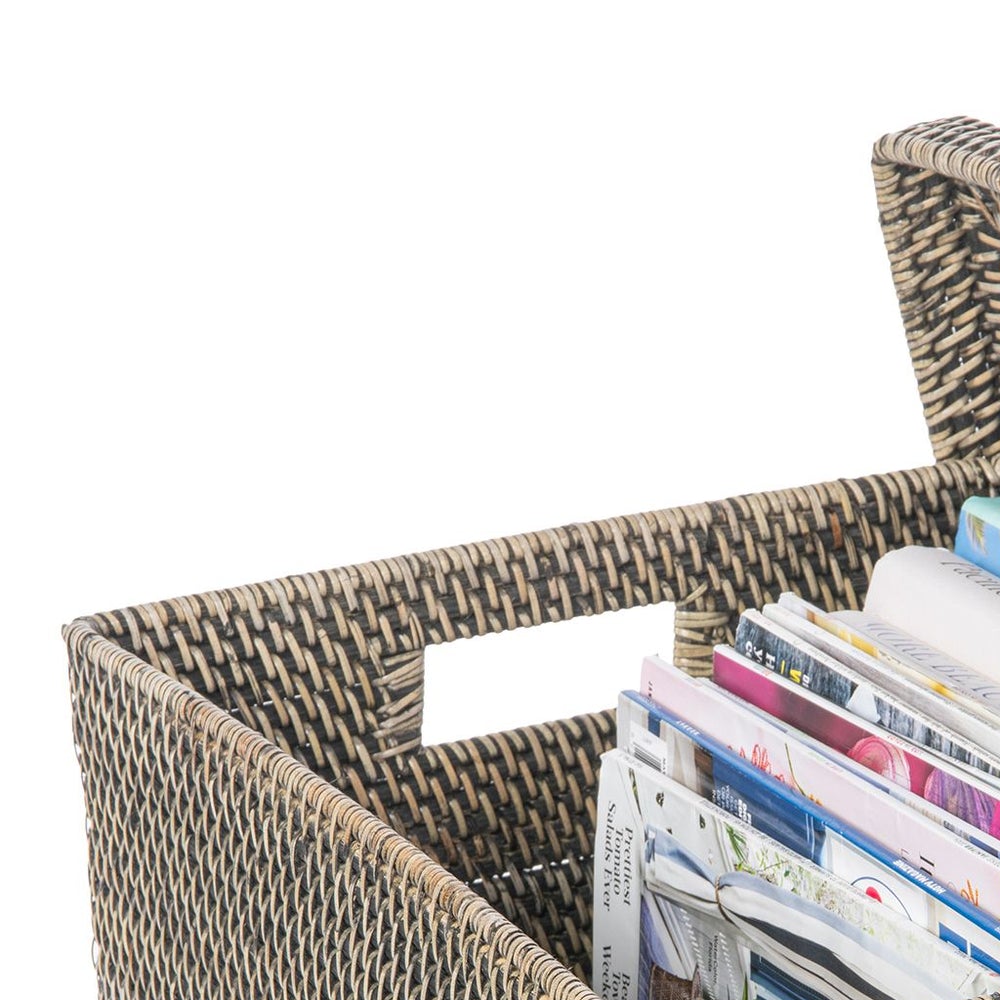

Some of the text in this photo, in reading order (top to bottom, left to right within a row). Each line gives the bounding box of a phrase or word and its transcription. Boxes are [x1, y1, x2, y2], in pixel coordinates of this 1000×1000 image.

[866, 622, 938, 661] MORE
[602, 801, 616, 911] Salads Ever
[613, 828, 625, 896] Tomato
[623, 827, 634, 905] Prettiest
